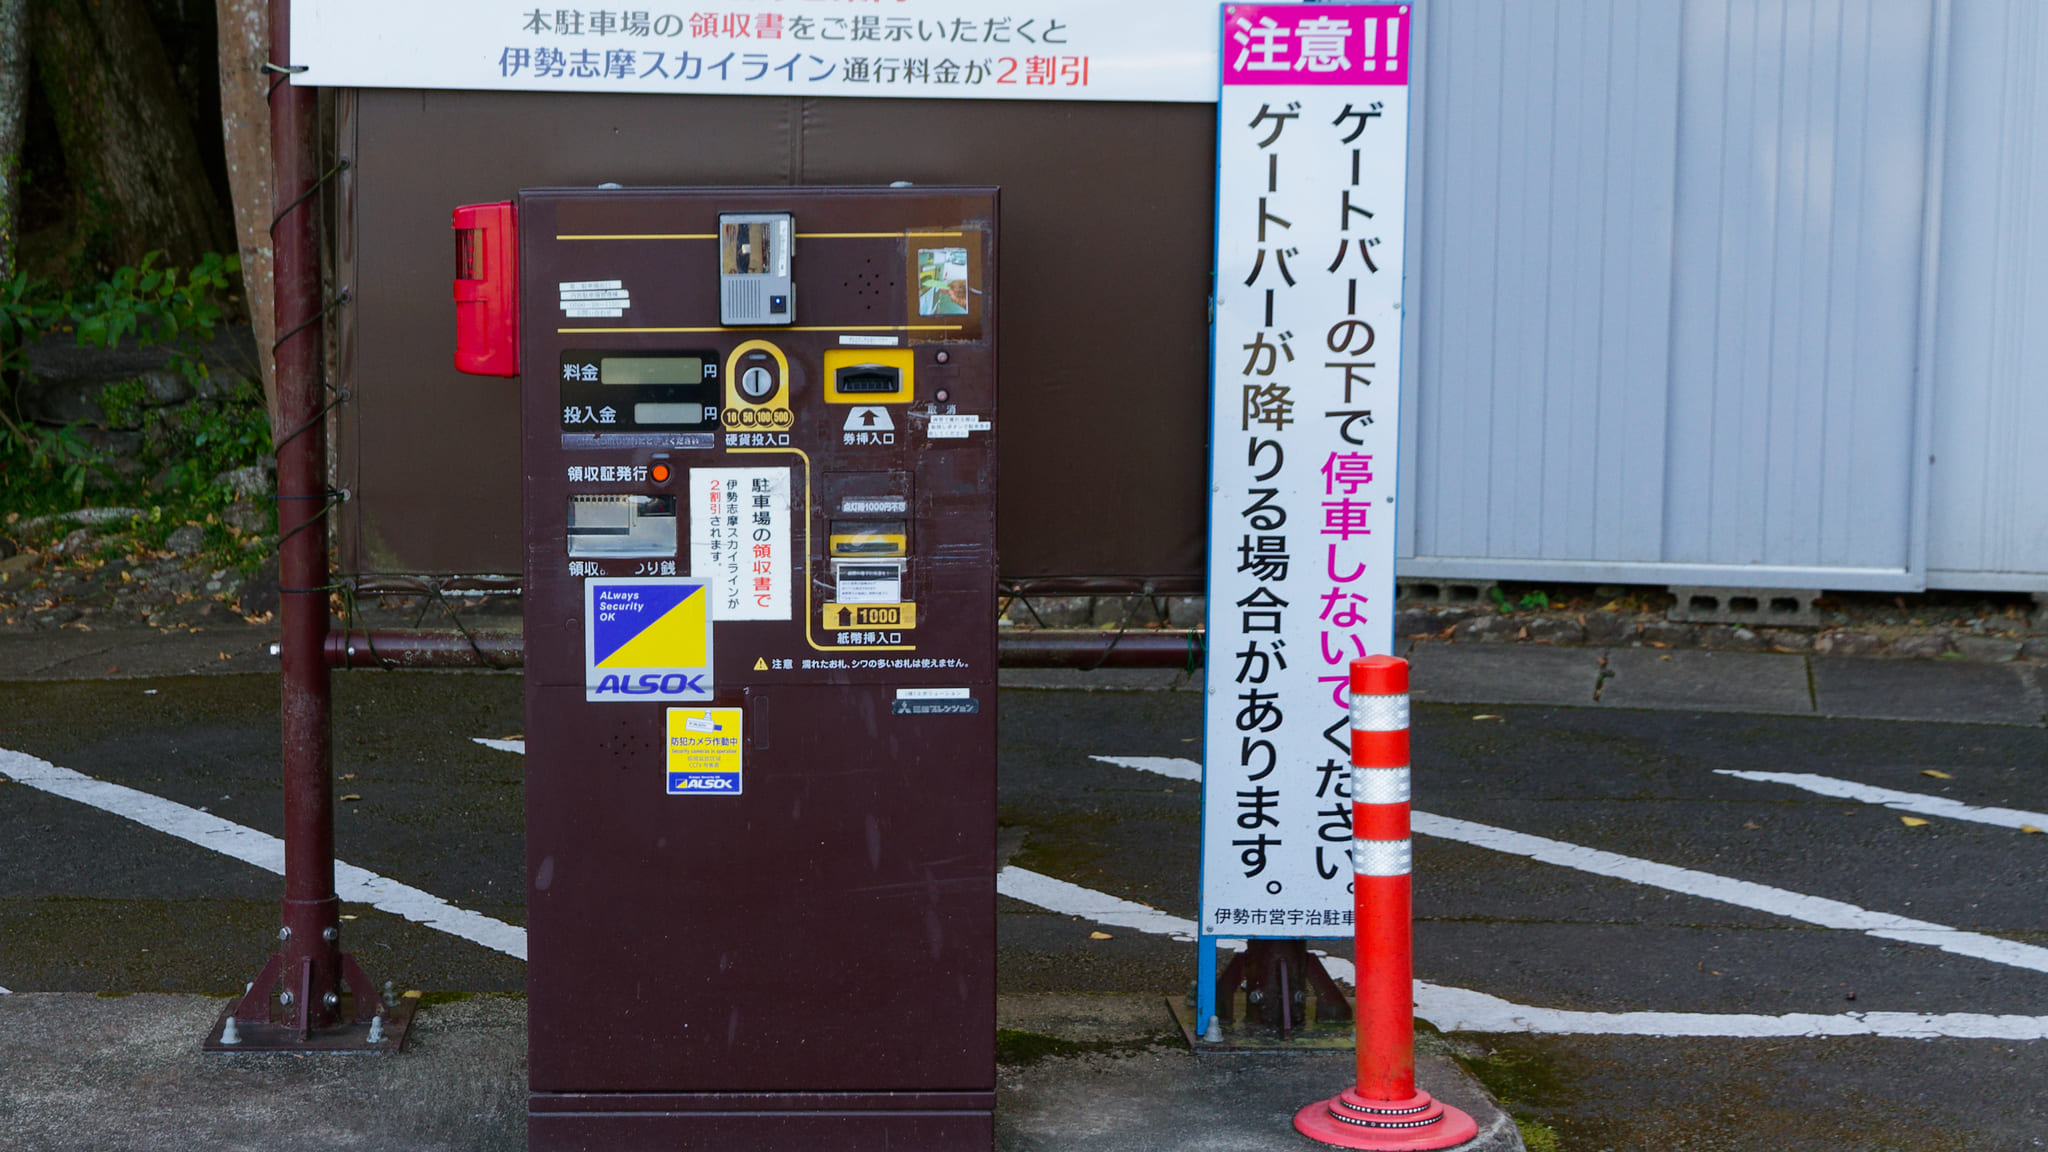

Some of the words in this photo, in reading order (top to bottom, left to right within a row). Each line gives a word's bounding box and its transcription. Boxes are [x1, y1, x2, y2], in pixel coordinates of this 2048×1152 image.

[522, 8, 1068, 43] 本駐車場の領収書をご提示いただくと
[1232, 15, 1400, 73] 注意!!
[498, 46, 1089, 86] 伊勢志摩スカイライン通行料金が2割引
[563, 363, 599, 382] 料金
[703, 363, 718, 379] 円
[563, 405, 617, 424] 投入金
[703, 405, 718, 421] 円
[726, 411, 738, 423] 10
[742, 411, 754, 423] 50
[757, 411, 771, 423] 100
[773, 411, 789, 423] 500
[725, 433, 790, 447] 硬貨投入口
[567, 465, 648, 482] 領収証発行
[1232, 101, 1303, 895] ゲートバーが降りる場合があります。
[709, 479, 722, 566] 2割引されます。
[726, 479, 740, 610] 伊勢志摩スカイラインが
[752, 478, 772, 607] 駐車場の領収書で
[600, 602, 644, 612] Security
[859, 608, 898, 624] 1000
[599, 612, 616, 622] OK
[836, 632, 902, 645] 紙幣挿入口
[771, 658, 794, 670] 注意
[595, 673, 706, 694] ALSOK
[670, 736, 738, 747] 防犯カメラ作動中
[687, 779, 733, 789] ALSOK
